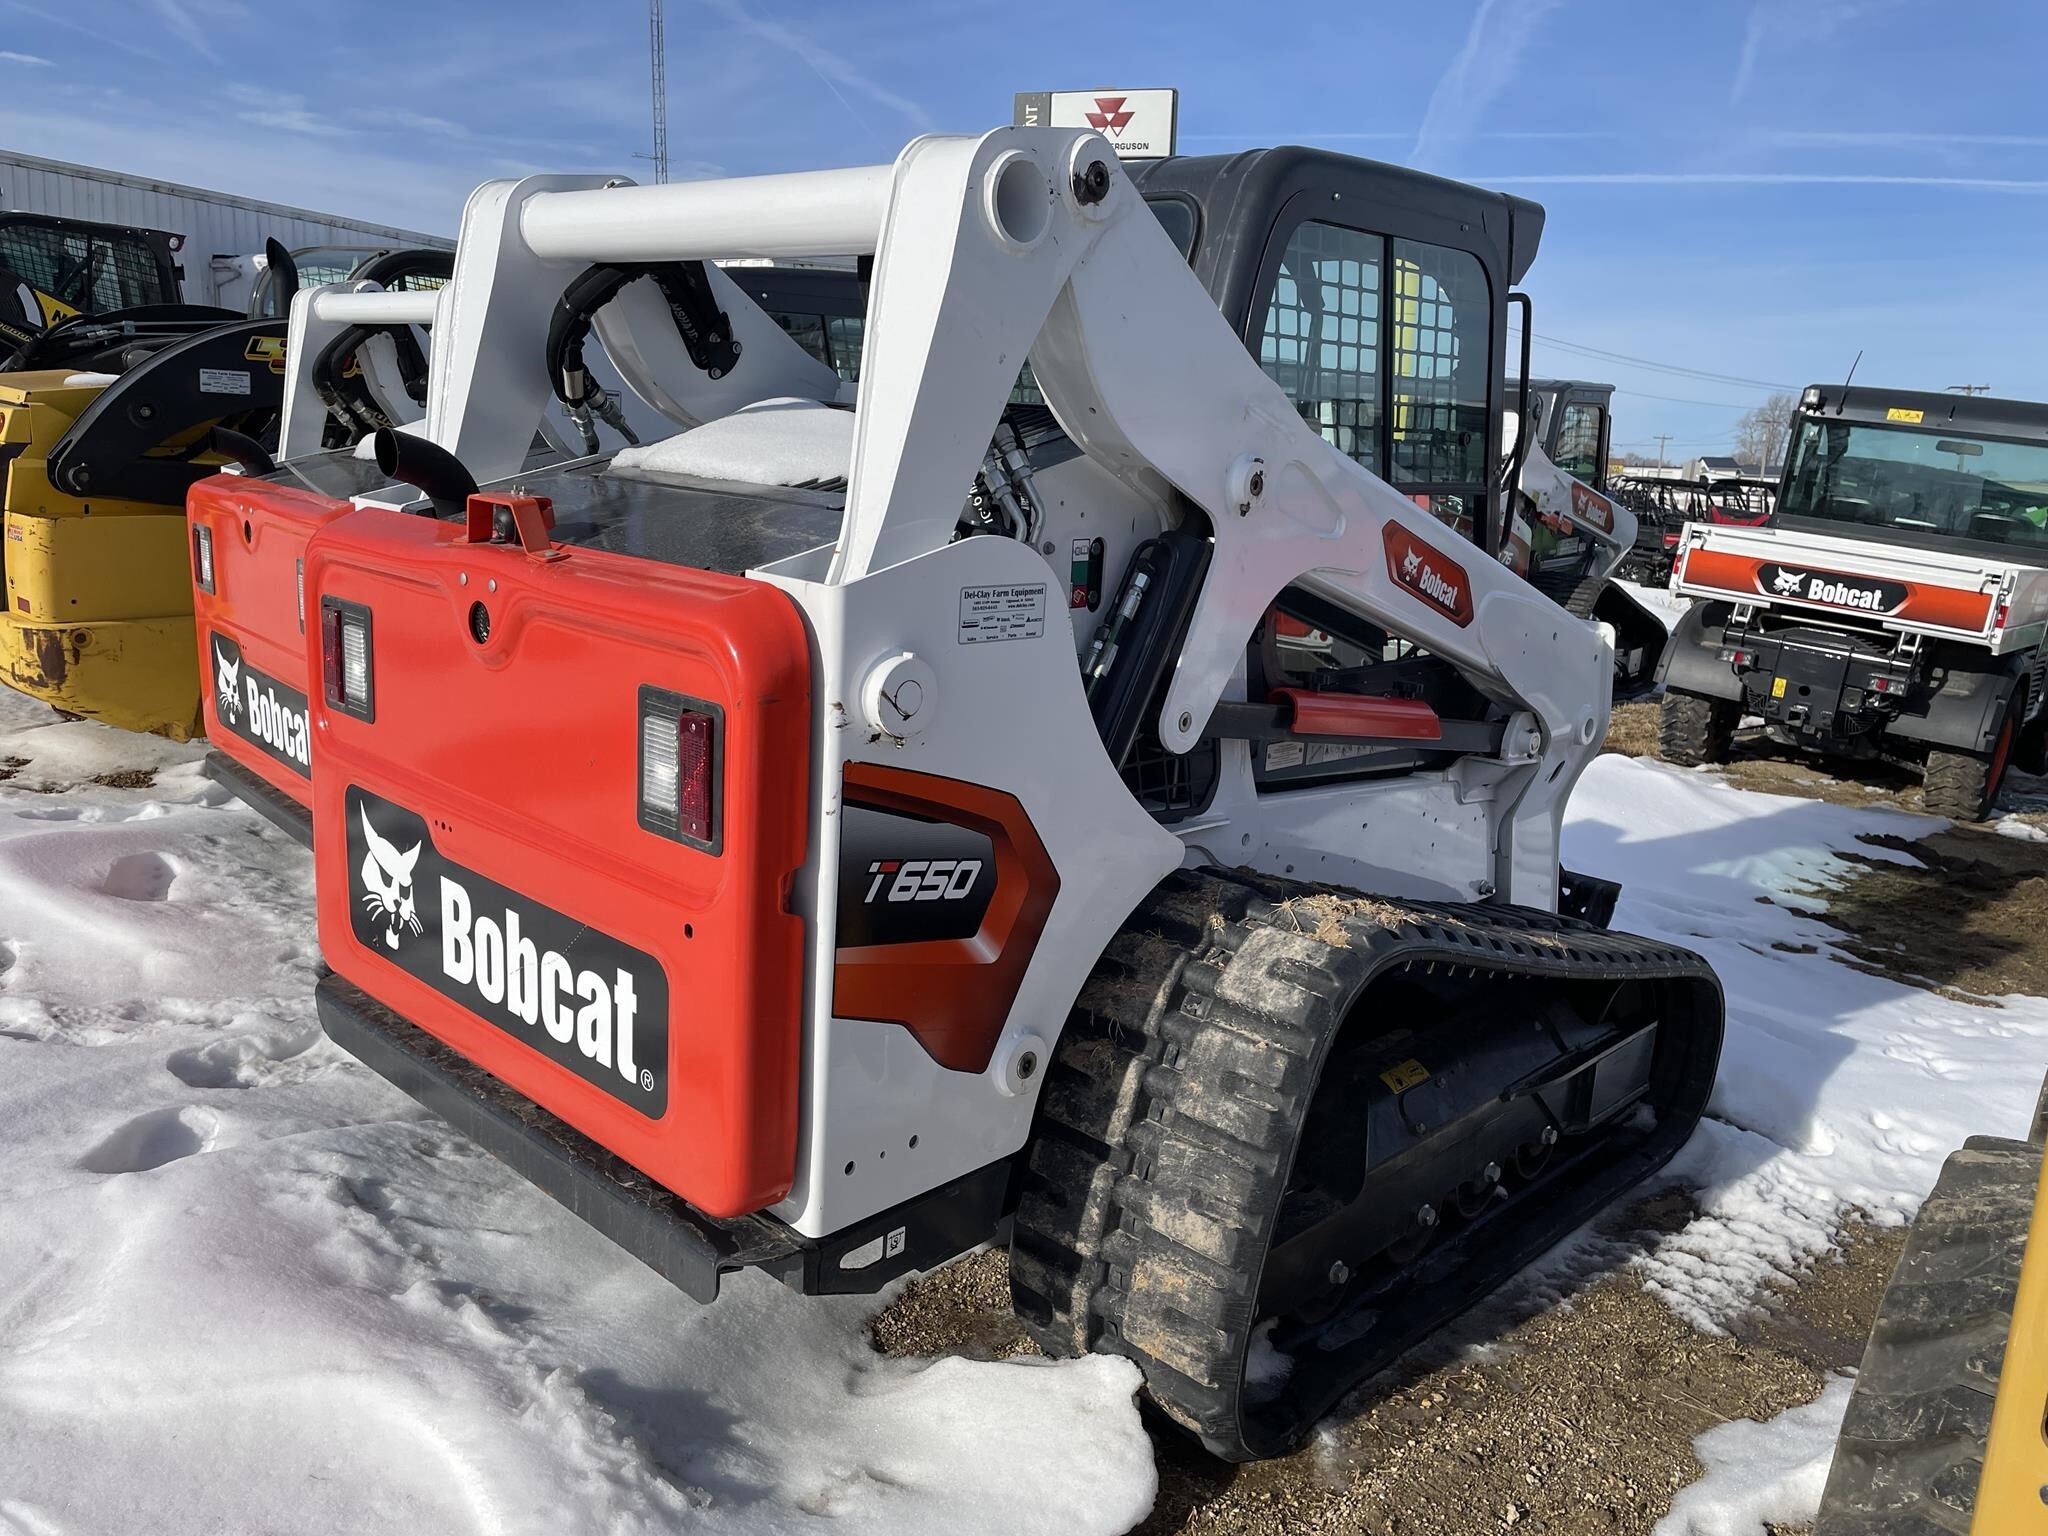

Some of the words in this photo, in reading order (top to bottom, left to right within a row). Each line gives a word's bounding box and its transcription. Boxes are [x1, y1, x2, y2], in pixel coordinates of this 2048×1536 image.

[1111, 142, 1149, 150] RGUSON
[964, 590, 991, 600] Del-Clay
[993, 589, 1009, 598] Farm
[1011, 587, 1044, 597] Equipment
[1419, 564, 1458, 609] Bobcat
[1808, 578, 1882, 611] Bobcat
[864, 860, 982, 903] T650
[440, 875, 638, 1085] Bobcat
